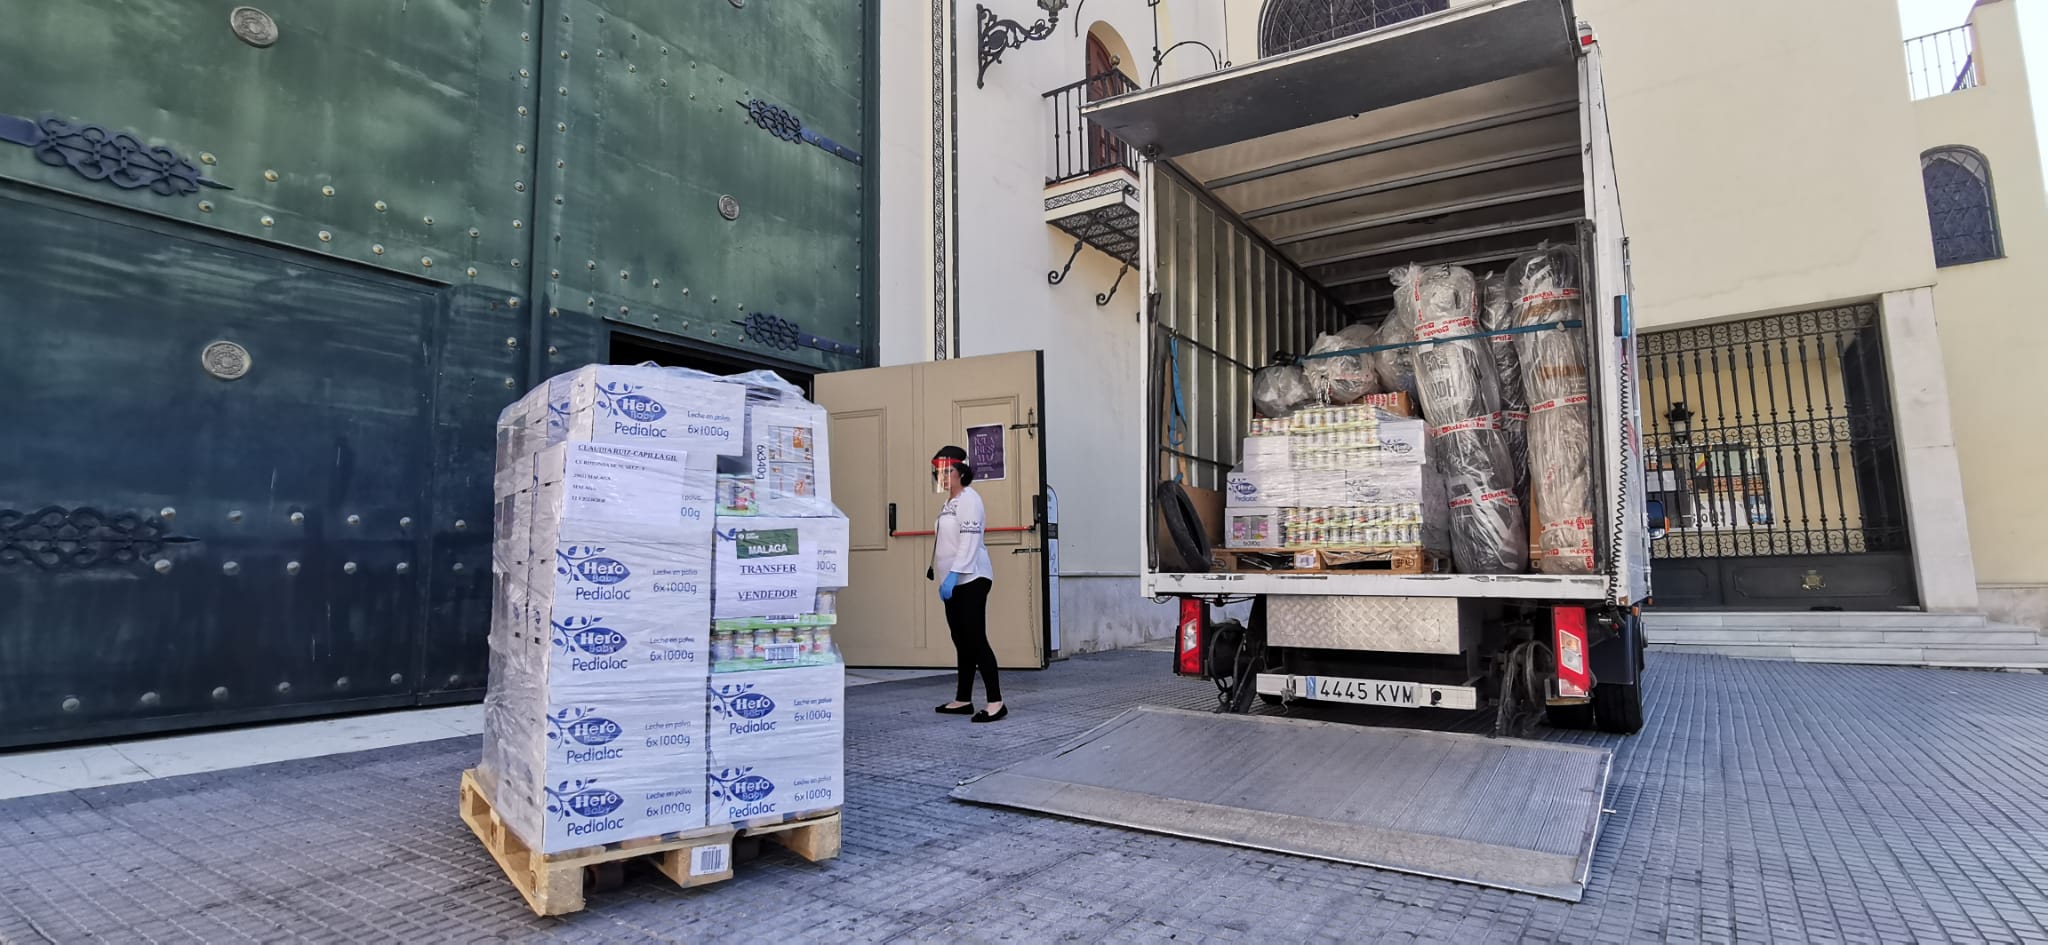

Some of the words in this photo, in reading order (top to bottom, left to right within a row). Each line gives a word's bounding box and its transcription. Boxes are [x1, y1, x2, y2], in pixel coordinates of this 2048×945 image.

[623, 399, 662, 413] Hero
[615, 422, 667, 438] Pedialac
[688, 424, 729, 440] 6x1000g
[579, 444, 613, 455] CLAUDIA
[613, 446, 664, 460] RUIZ-CAPILLA
[664, 454, 678, 462] GIL
[755, 445, 766, 480] 6x340g
[584, 561, 624, 575] Hero
[740, 563, 797, 574] TRANSFER
[576, 587, 631, 600] Pedialac
[653, 582, 697, 595] 6x1000g
[738, 589, 798, 600] VENDEDOR
[580, 631, 621, 645] Hero
[650, 649, 694, 662] 6x1000g
[572, 657, 628, 671] Pedialac
[1321, 680, 1368, 700] 4445
[1376, 683, 1413, 704] KVM
[736, 696, 771, 710] Hero
[794, 710, 832, 722] 6x1000g
[574, 722, 616, 737] Hero
[730, 719, 777, 735] Pedialac
[646, 734, 690, 747] 6x1000g
[567, 746, 623, 764] Pedialac
[735, 778, 770, 794] Hero
[575, 793, 617, 808] Hero
[646, 792, 665, 800] Leche
[794, 788, 832, 801] 6x1000g
[646, 802, 691, 817] 6x1000g
[729, 802, 776, 819] Pedialac
[568, 818, 624, 837] Pedialac
